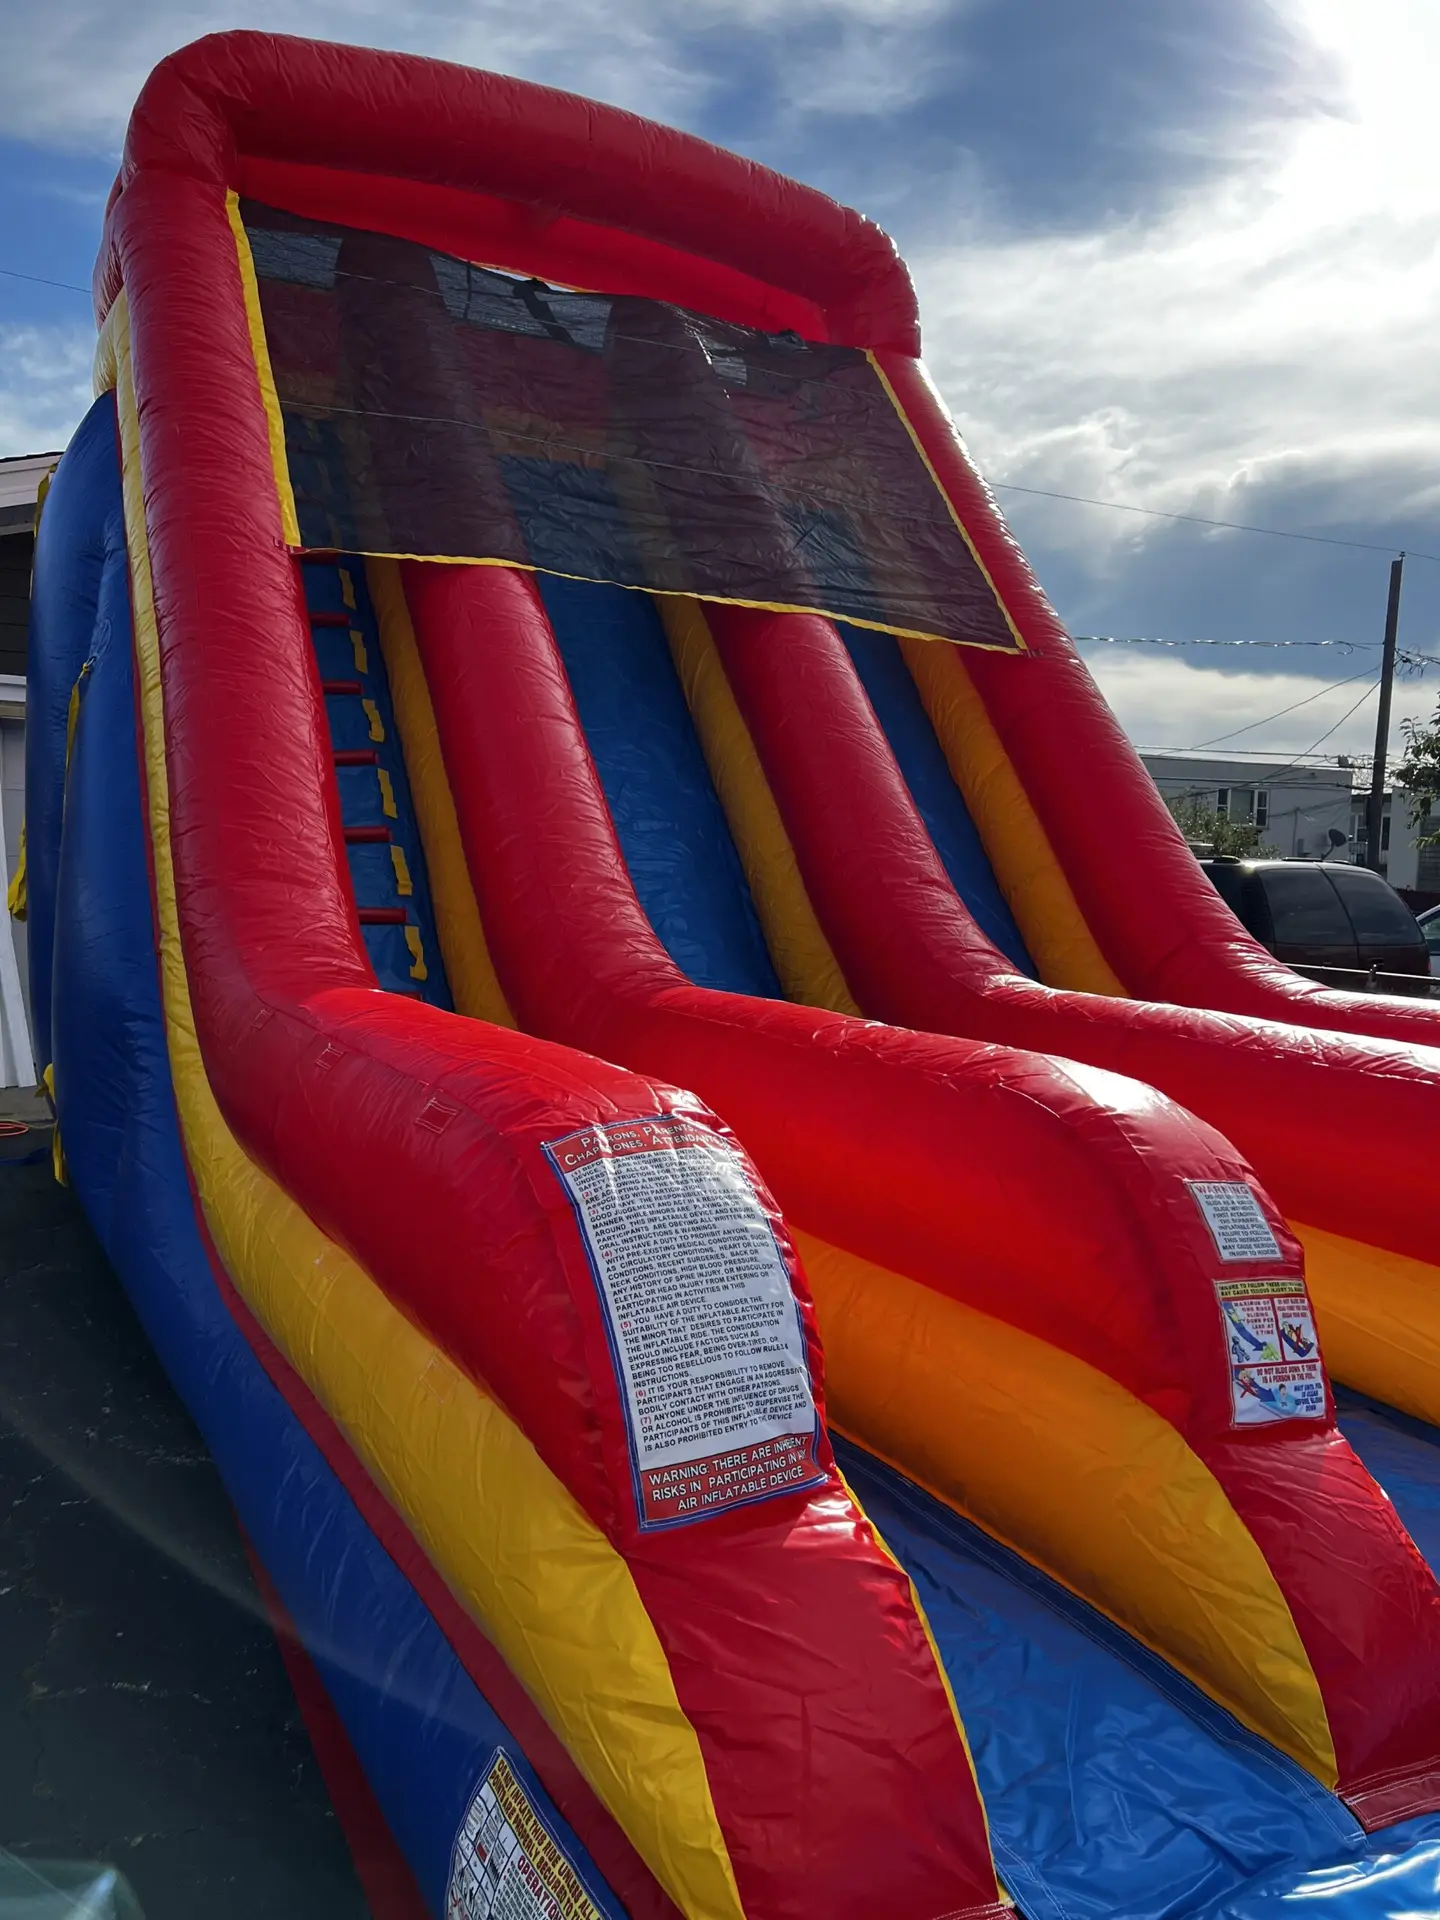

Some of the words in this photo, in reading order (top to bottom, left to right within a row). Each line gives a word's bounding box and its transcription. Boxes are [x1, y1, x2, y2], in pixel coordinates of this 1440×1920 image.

[596, 1225, 649, 1244] PARTICIPANTS
[652, 1222, 666, 1230] ARE
[668, 1218, 699, 1228] OBEYING
[601, 1250, 612, 1259] (4)
[613, 1245, 630, 1254] YOU
[631, 1240, 651, 1249] HAVE
[659, 1236, 677, 1244] DUTY
[689, 1230, 720, 1239] PROHIBIT
[722, 1226, 749, 1235] ANYONE
[605, 1254, 625, 1265] WITH
[626, 1244, 675, 1259] PRE-EXISTING
[676, 1240, 706, 1249] MEDICAL
[609, 1277, 631, 1289] NECK
[680, 1264, 698, 1272] HIGH
[698, 1261, 722, 1270] BLOOD
[723, 1256, 758, 1266] PRESSURE
[613, 1291, 643, 1304] ELETAL
[644, 1288, 656, 1296] OR
[657, 1284, 678, 1293] HEAD
[678, 1279, 703, 1289] INJURY
[704, 1276, 725, 1284] FROM
[725, 1271, 759, 1282] ENTERING
[615, 1293, 673, 1312] PARTICIPATING
[683, 1285, 721, 1297] ACTIVITIES
[729, 1281, 746, 1289] THIS
[617, 1303, 664, 1320] INFLATABLE
[666, 1300, 679, 1309] AIR
[622, 1320, 667, 1337] SUITABILITY
[669, 1317, 679, 1326] OF
[680, 1314, 695, 1323] THE
[696, 1307, 739, 1320] INFLATABLE
[740, 1302, 769, 1313] ACTIVITY
[770, 1300, 784, 1308] FOR
[623, 1335, 640, 1345] THE
[640, 1329, 666, 1341] MINOR
[667, 1325, 686, 1334] THAT
[689, 1319, 721, 1331] DESIRES
[721, 1316, 732, 1324] TO
[732, 1310, 775, 1322] PARTICIPATE
[625, 1344, 641, 1354] THE
[642, 1334, 688, 1349] INFLATABLE
[710, 1326, 725, 1335] THE
[725, 1318, 779, 1332] CONSIDERATION
[627, 1349, 660, 1363] SHOULD
[661, 1341, 694, 1354] INCLUDE
[695, 1335, 729, 1347] FACTORS
[729, 1331, 749, 1340] SUCH
[750, 1329, 759, 1337] AS
[629, 1354, 678, 1371] EXPRESSING
[703, 1343, 726, 1355] BEING
[769, 1335, 778, 1343] OR
[647, 1386, 655, 1394] IT
[656, 1384, 665, 1392] IS
[666, 1379, 688, 1390] YOUR
[689, 1366, 748, 1384] RESPONSIBILITY
[749, 1364, 758, 1372] TO
[758, 1360, 785, 1370] REMOVE
[637, 1402, 667, 1415] BODILY
[669, 1393, 705, 1408] CONTACT
[706, 1389, 726, 1399] WITH
[727, 1384, 750, 1395] OTHER
[639, 1415, 651, 1425] (7)
[653, 1407, 685, 1421] ANYONE
[687, 1401, 714, 1413] UNDER
[714, 1397, 730, 1407] THE
[731, 1389, 767, 1403] INFLUENCE
[767, 1387, 776, 1396] OF
[777, 1384, 799, 1394] DRUGS
[648, 1463, 708, 1484] WARNING:
[712, 1452, 747, 1470] THERE
[751, 1445, 771, 1461] ARE
[652, 1483, 686, 1500] RISKS
[689, 1480, 701, 1492] IN
[708, 1456, 786, 1487] PARTICIPATING
[787, 1452, 797, 1464] IN
[677, 1496, 697, 1510] AIR
[701, 1477, 766, 1504] INFLATABLE
[529, 1819, 547, 1846] THIS
[541, 1840, 562, 1869] RIDE
